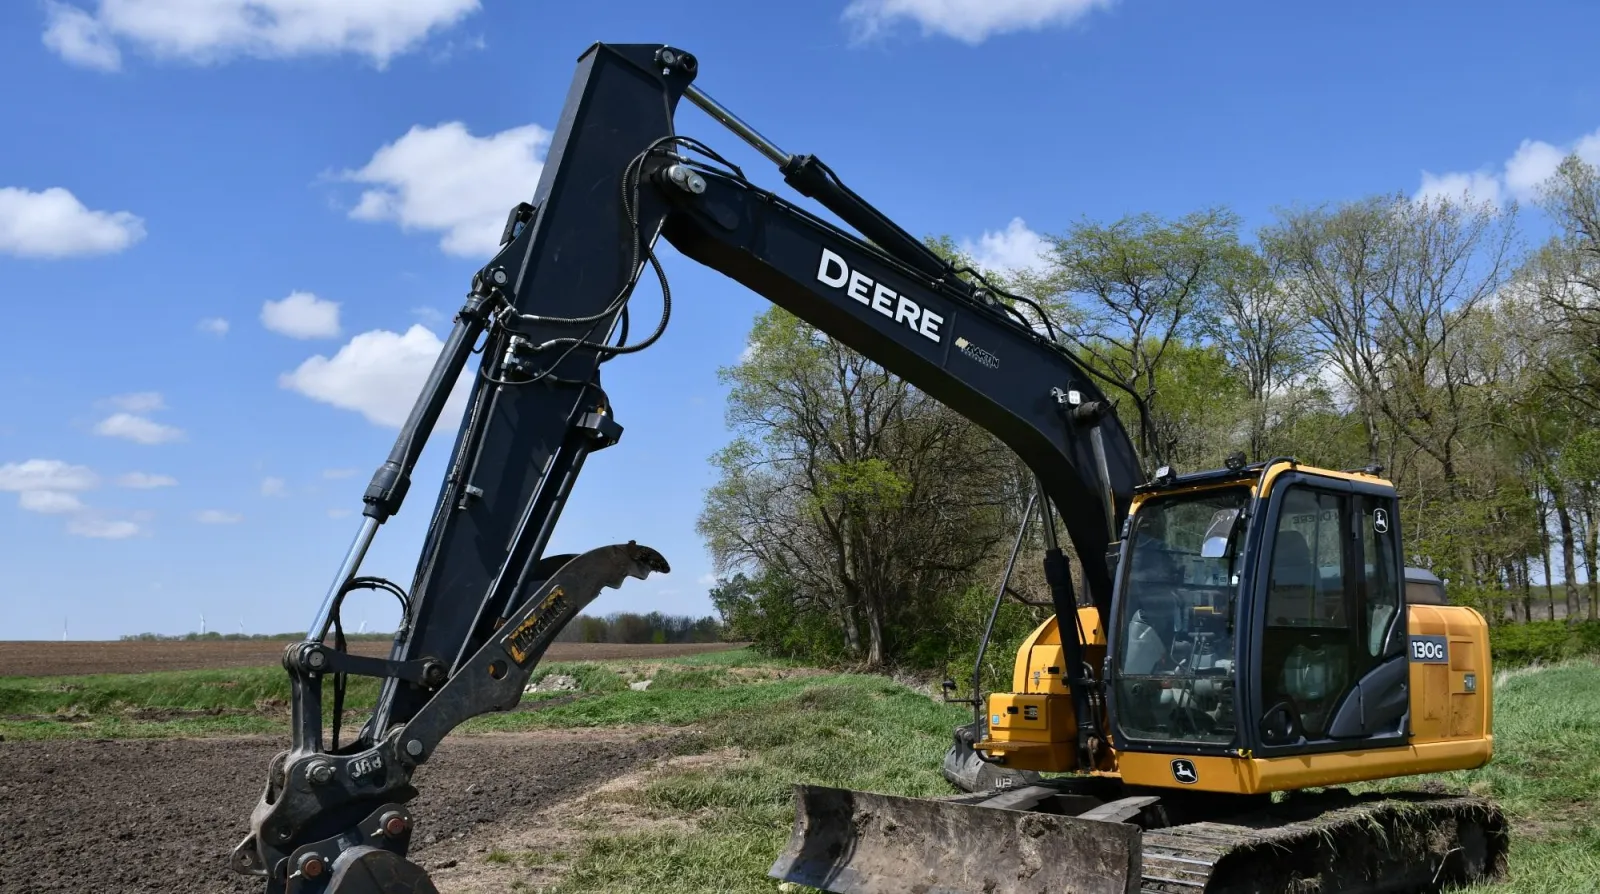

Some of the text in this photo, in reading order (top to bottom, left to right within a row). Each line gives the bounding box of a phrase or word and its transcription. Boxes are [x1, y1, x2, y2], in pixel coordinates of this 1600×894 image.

[817, 248, 944, 343] DEERE
[966, 341, 1000, 369] MARTIN
[1412, 641, 1443, 659] 130G
